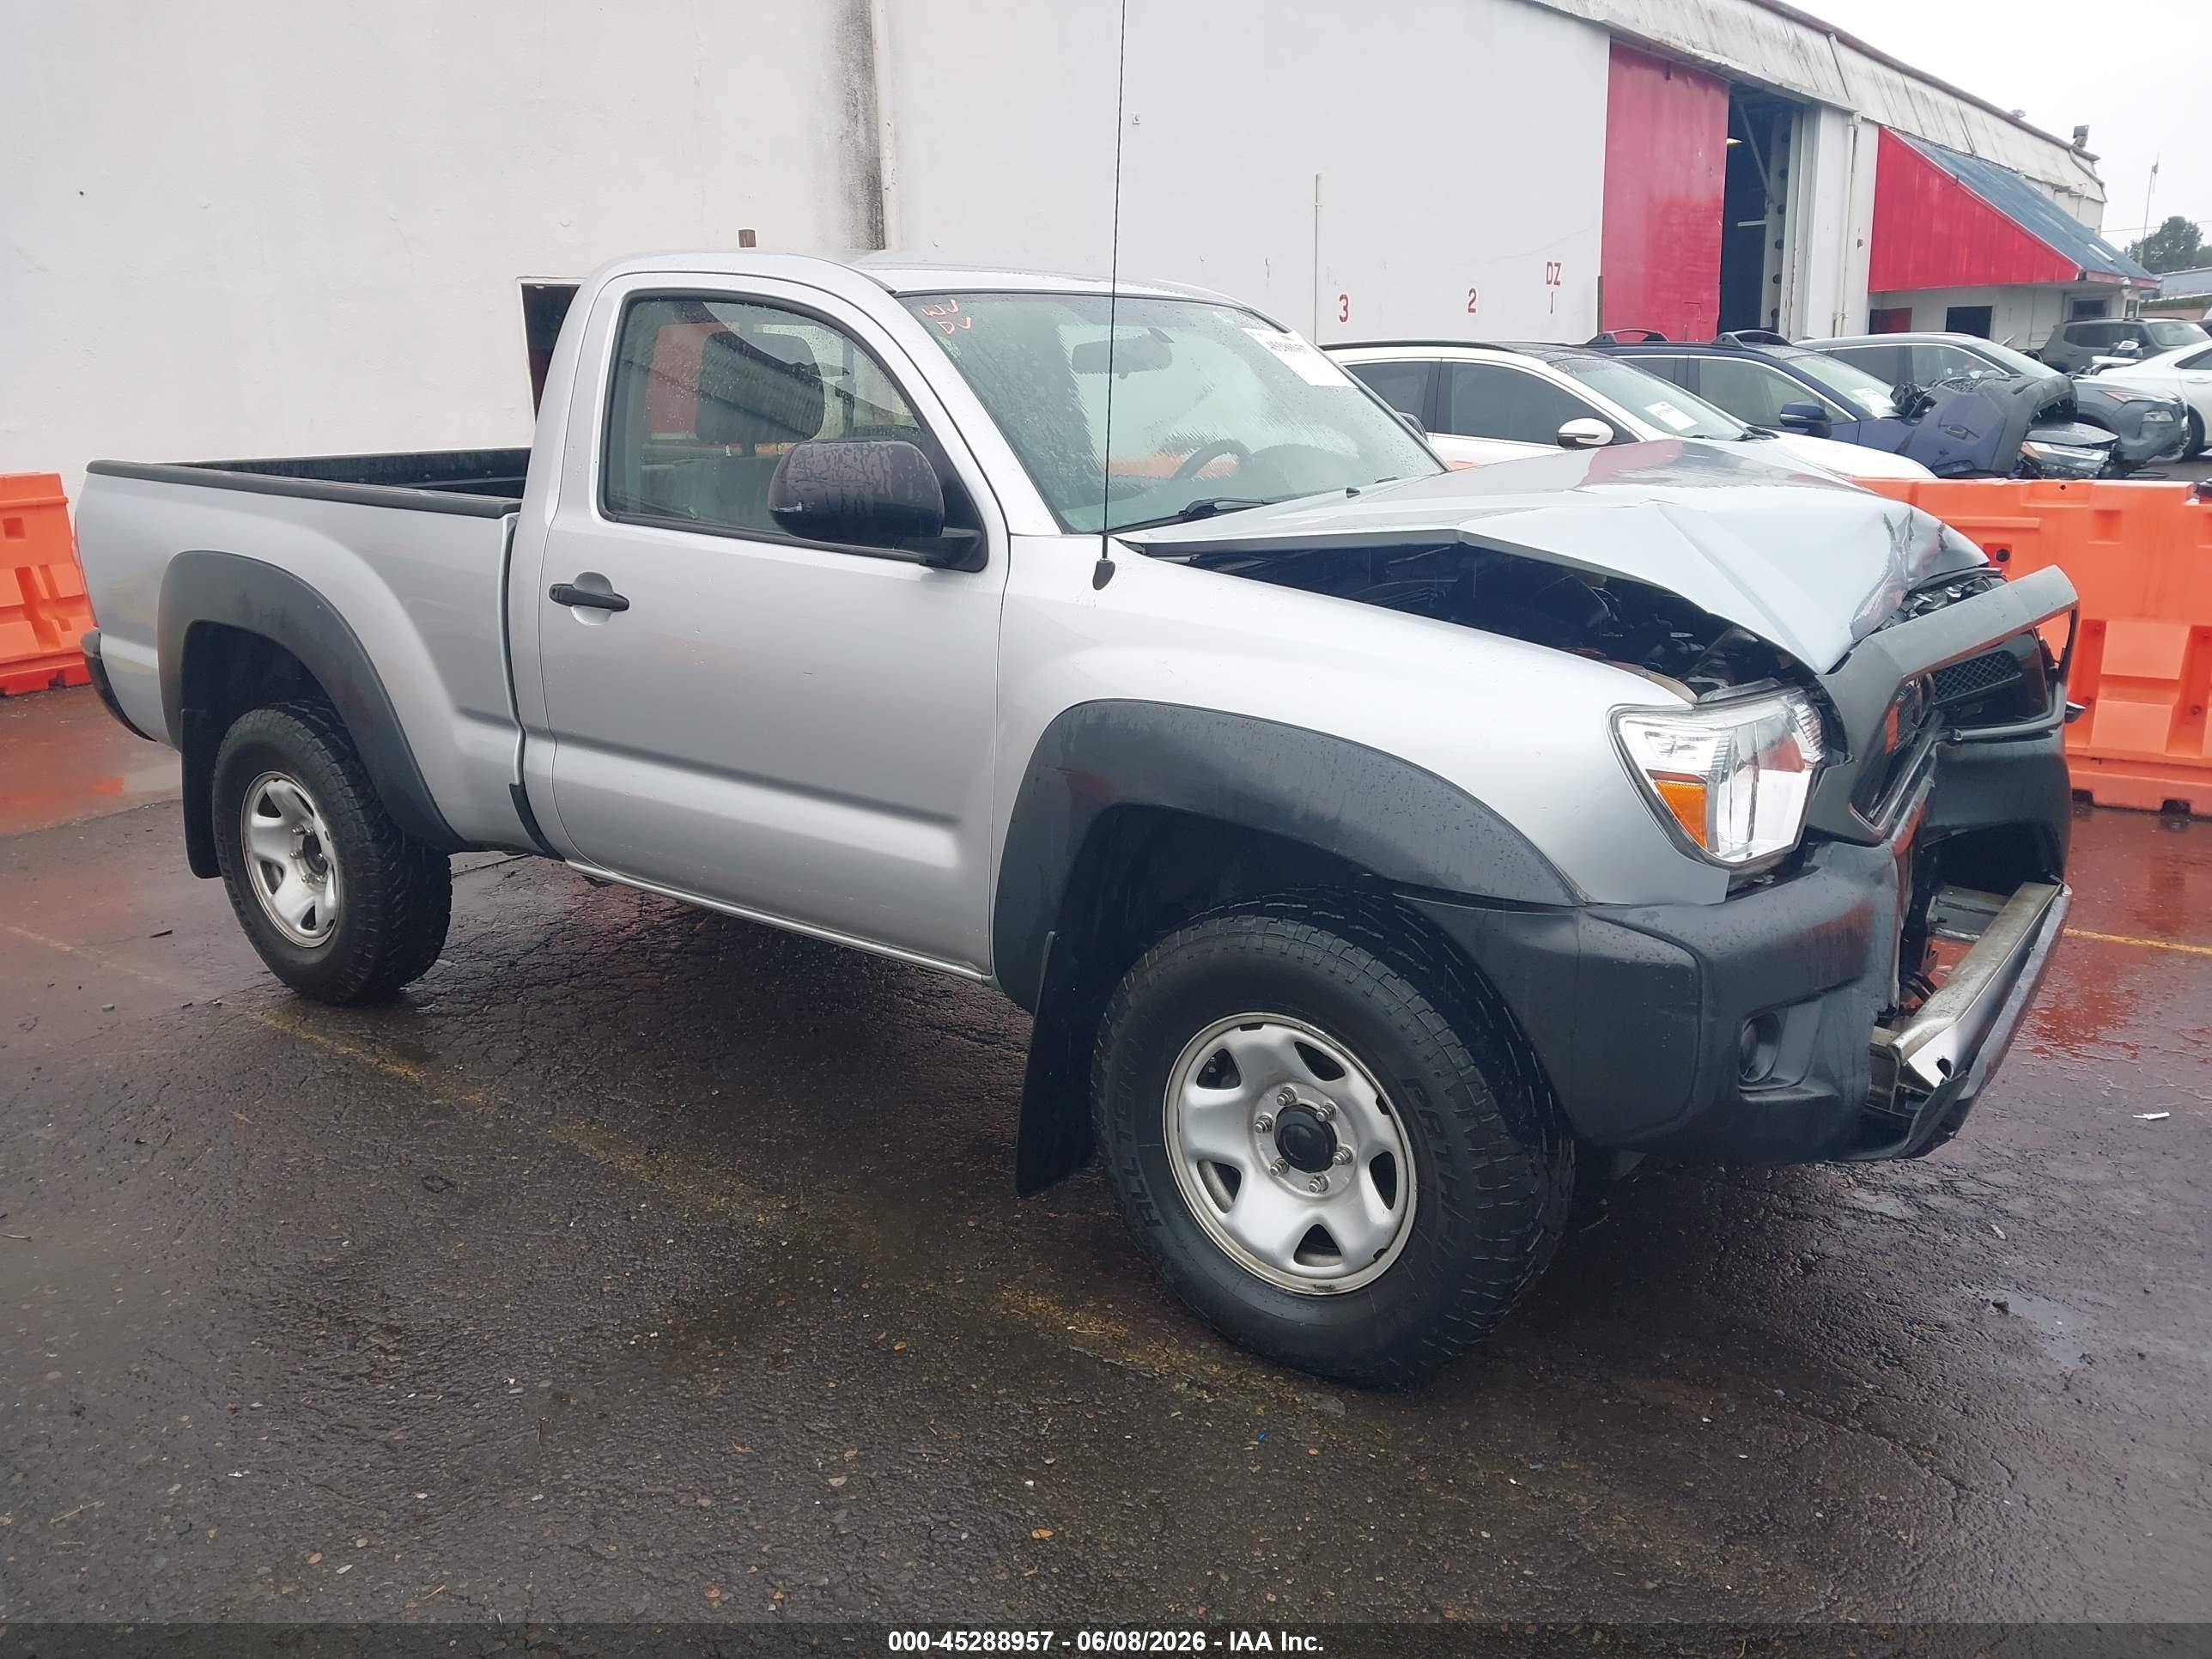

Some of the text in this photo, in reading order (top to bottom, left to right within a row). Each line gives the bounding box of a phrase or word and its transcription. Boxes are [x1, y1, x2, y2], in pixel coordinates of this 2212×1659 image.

[1546, 261, 1562, 288] DZ
[1339, 294, 1349, 323] 3
[1468, 288, 1477, 313] 2
